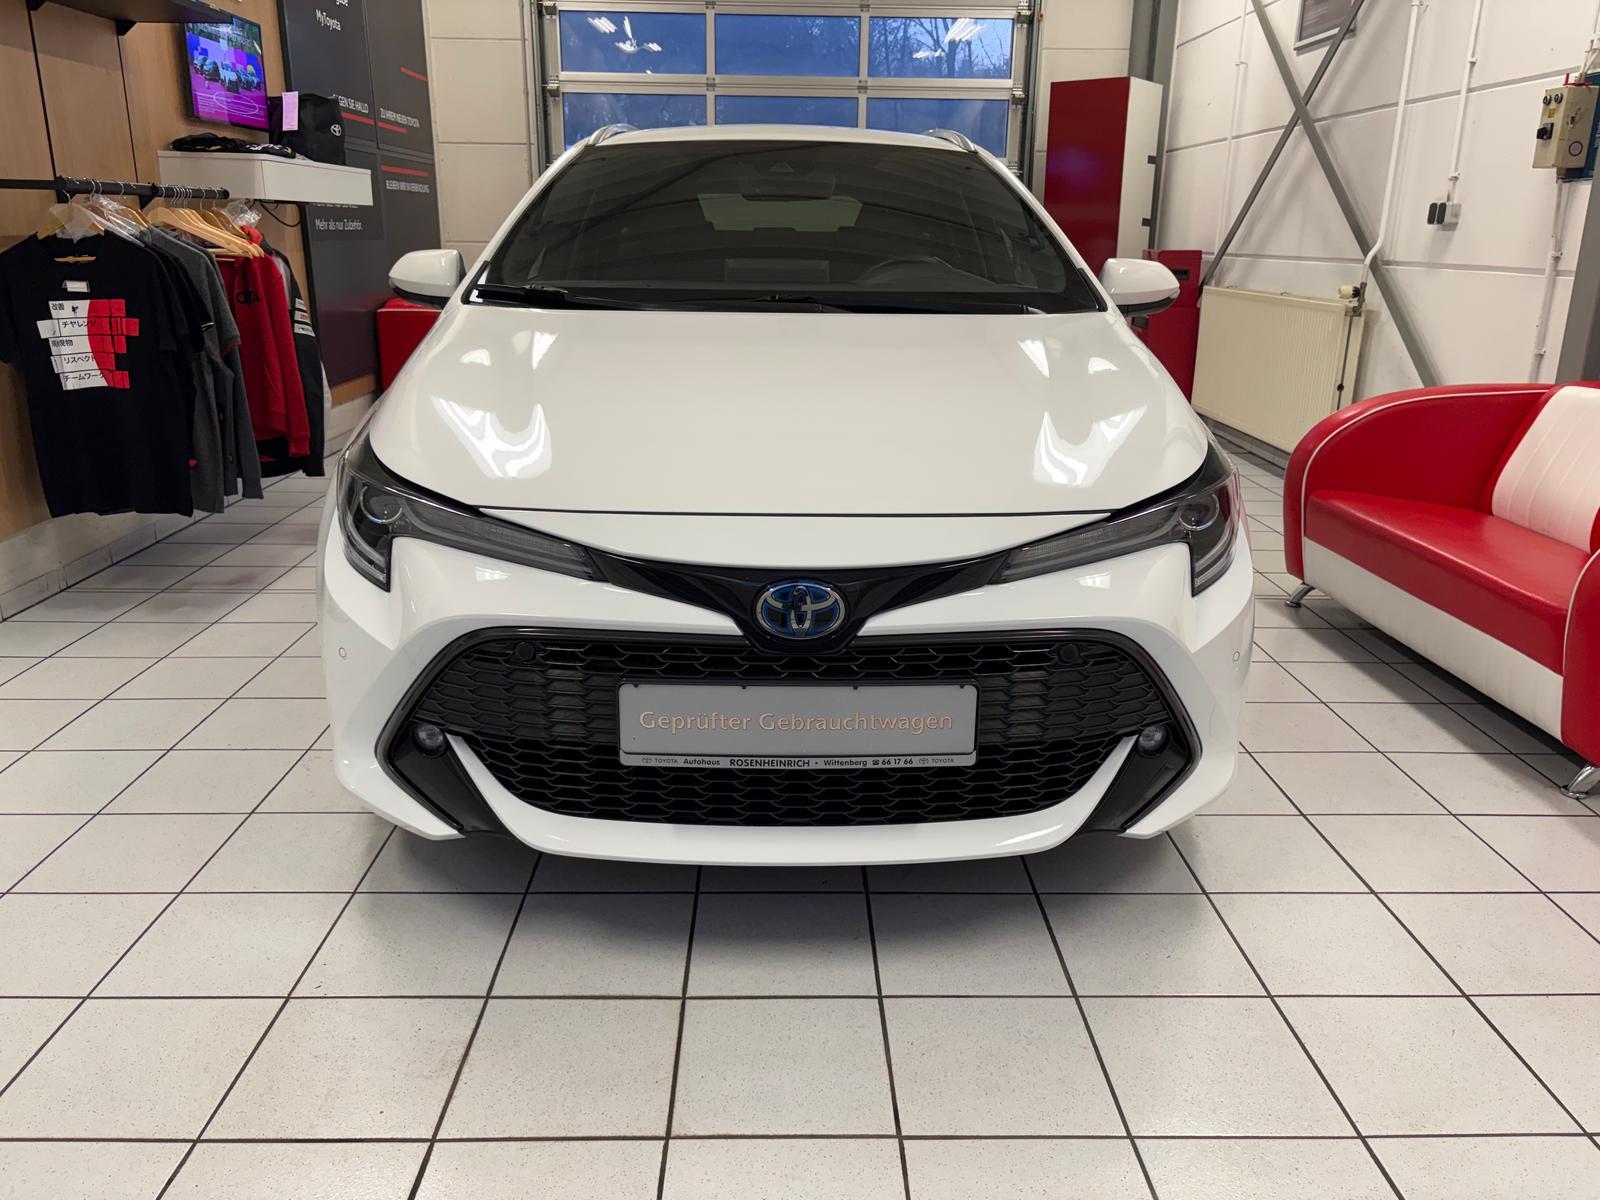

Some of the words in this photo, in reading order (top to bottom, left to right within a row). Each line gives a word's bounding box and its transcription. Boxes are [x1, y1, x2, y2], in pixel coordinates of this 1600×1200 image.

[315, 9, 341, 30] MyToyota
[315, 217, 327, 230] Mehr
[639, 710, 751, 735] Geprüfter
[759, 711, 953, 735] Gebrauchtwagen
[683, 757, 720, 766] Autohaus
[729, 758, 810, 768] ROSENHEINRICH
[823, 758, 868, 768] Wittenberg
[881, 758, 892, 766] 66
[893, 758, 901, 766] 17
[903, 757, 914, 766] 66
